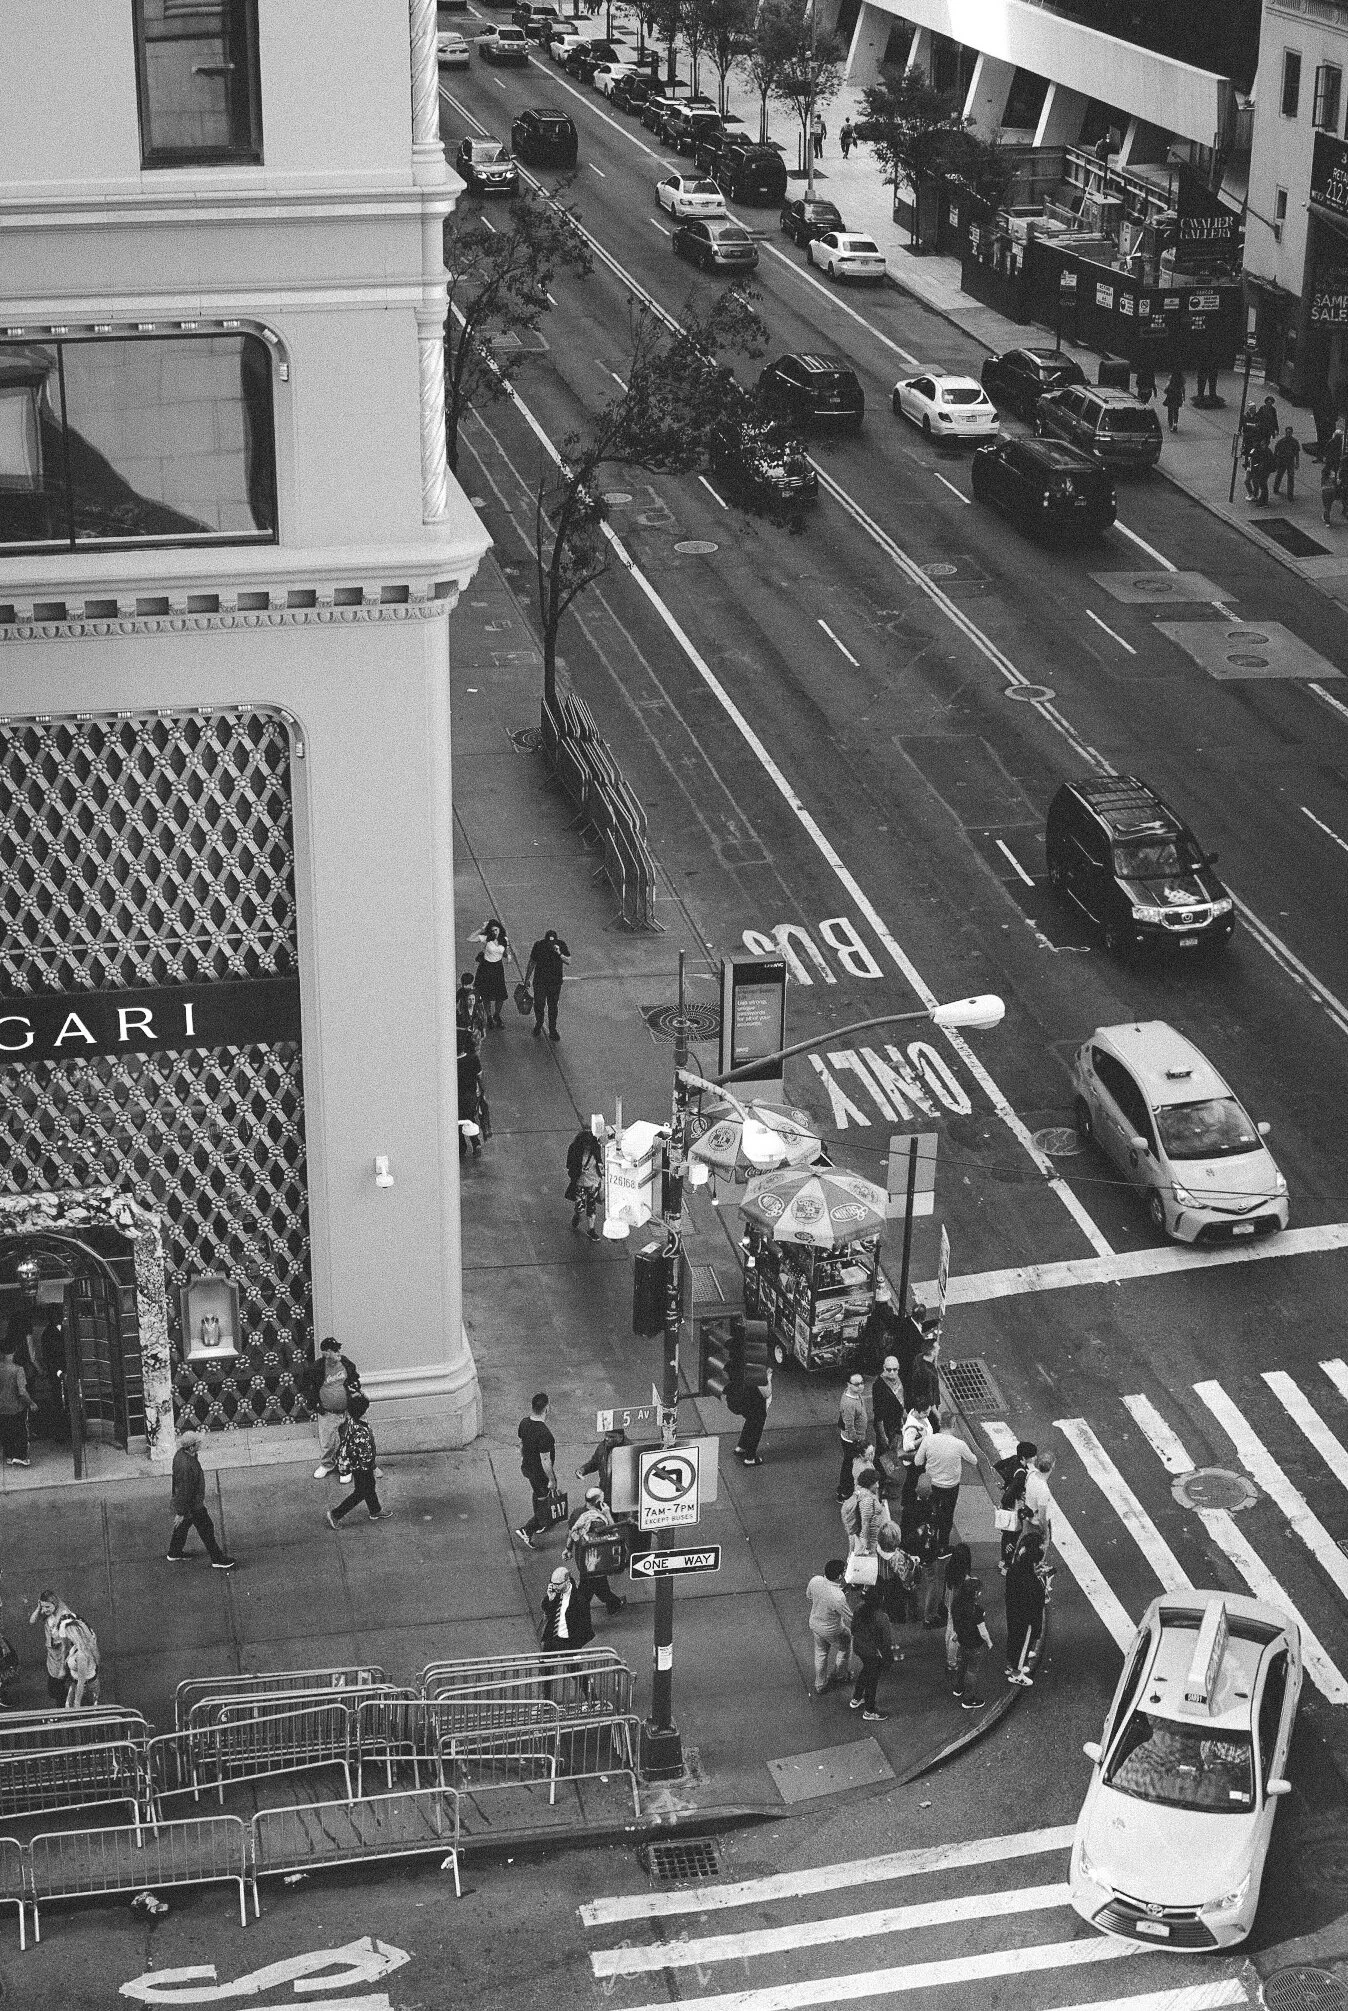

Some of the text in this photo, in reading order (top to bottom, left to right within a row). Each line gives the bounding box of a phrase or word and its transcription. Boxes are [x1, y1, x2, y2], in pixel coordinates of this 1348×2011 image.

[1179, 216, 1234, 229] CAVALIER
[1179, 228, 1231, 240] GALLERY
[807, 1041, 973, 1130] ONLY
[623, 1410, 631, 1427] 5
[645, 1514, 694, 1525] EXCEPT BUSES
[643, 1554, 711, 1570] ONE WAY
